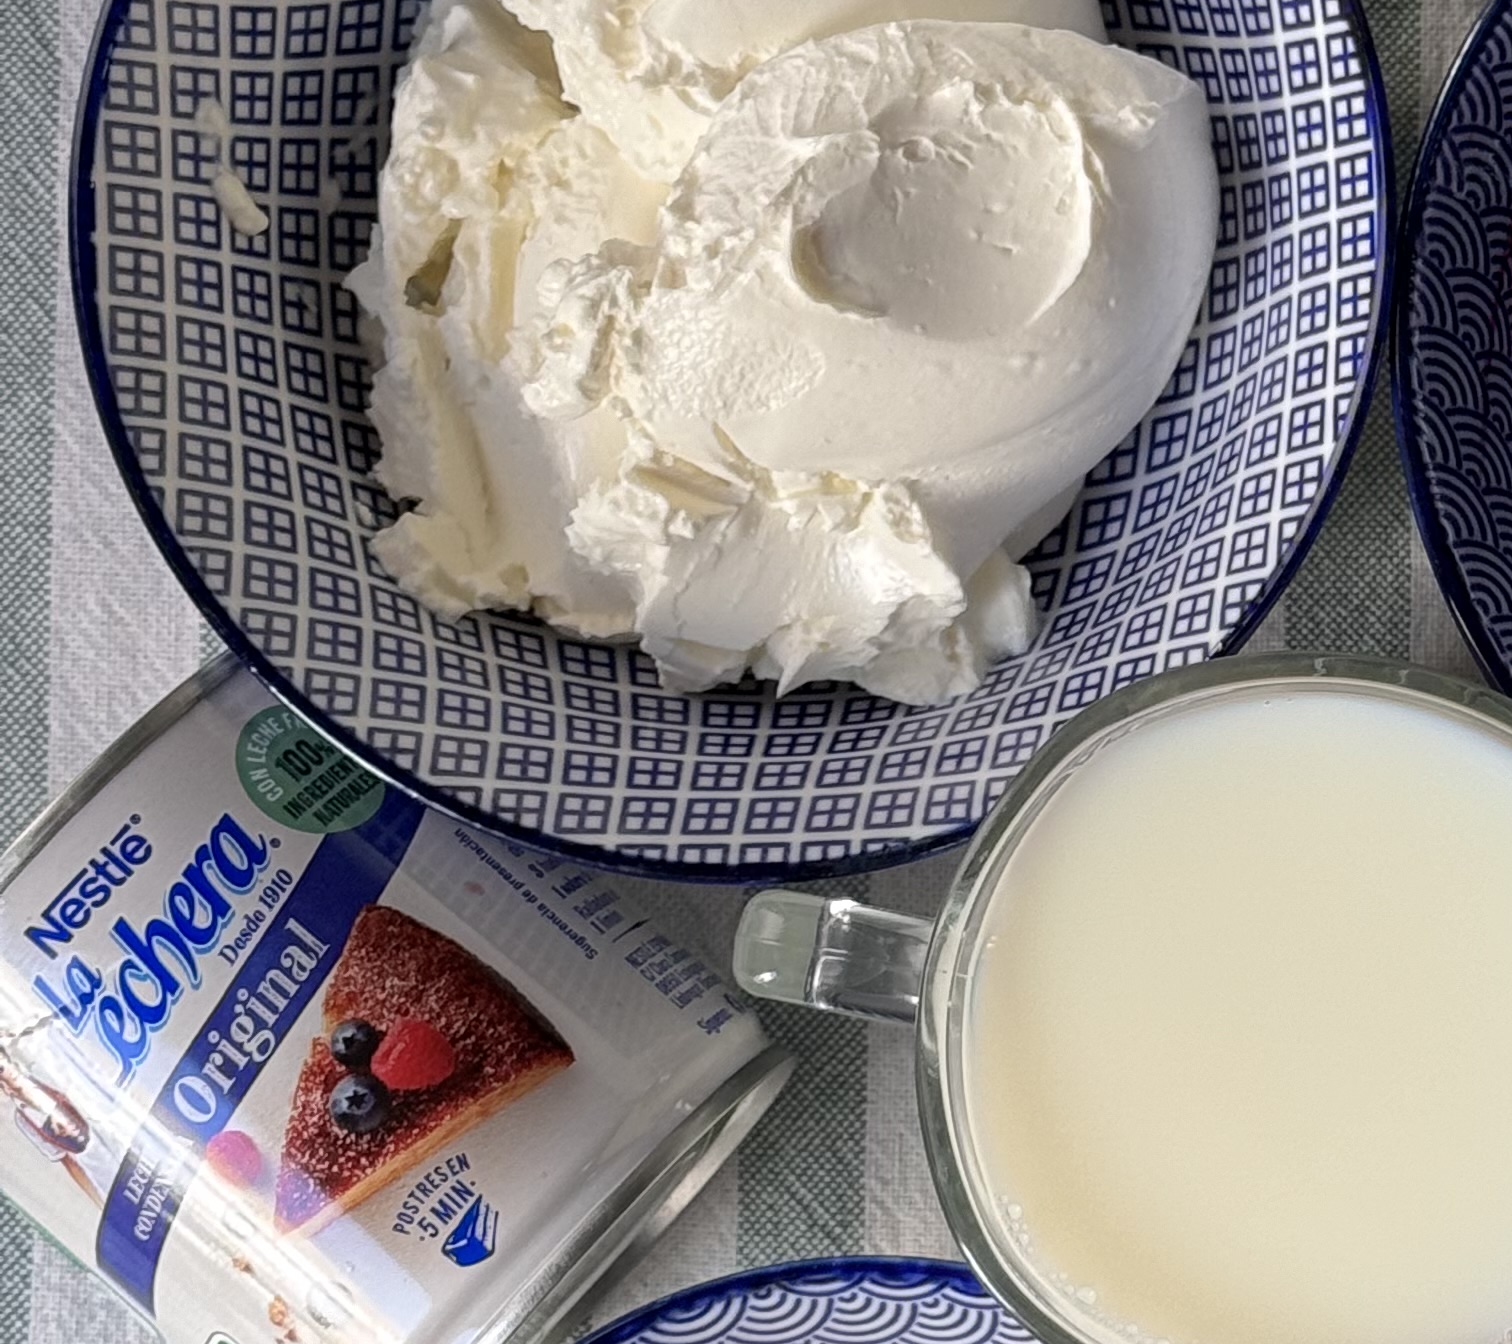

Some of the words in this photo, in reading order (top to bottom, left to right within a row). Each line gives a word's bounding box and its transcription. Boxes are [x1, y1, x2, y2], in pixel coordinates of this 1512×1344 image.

[247, 717, 285, 763] LECHE
[275, 739, 336, 783] 100%
[249, 770, 284, 802] CON
[282, 755, 361, 821] INGREDIENT
[454, 828, 524, 890] presentación
[24, 823, 153, 960] Nestlé
[218, 909, 266, 967] Desde
[259, 869, 293, 912] 1910
[522, 887, 538, 904] de
[537, 901, 598, 960] Sugerencia
[32, 956, 102, 1032] La
[174, 917, 330, 1123] Original
[123, 1157, 157, 1205] LECH
[392, 1166, 449, 1235] POSTRES
[445, 1153, 471, 1176] EN
